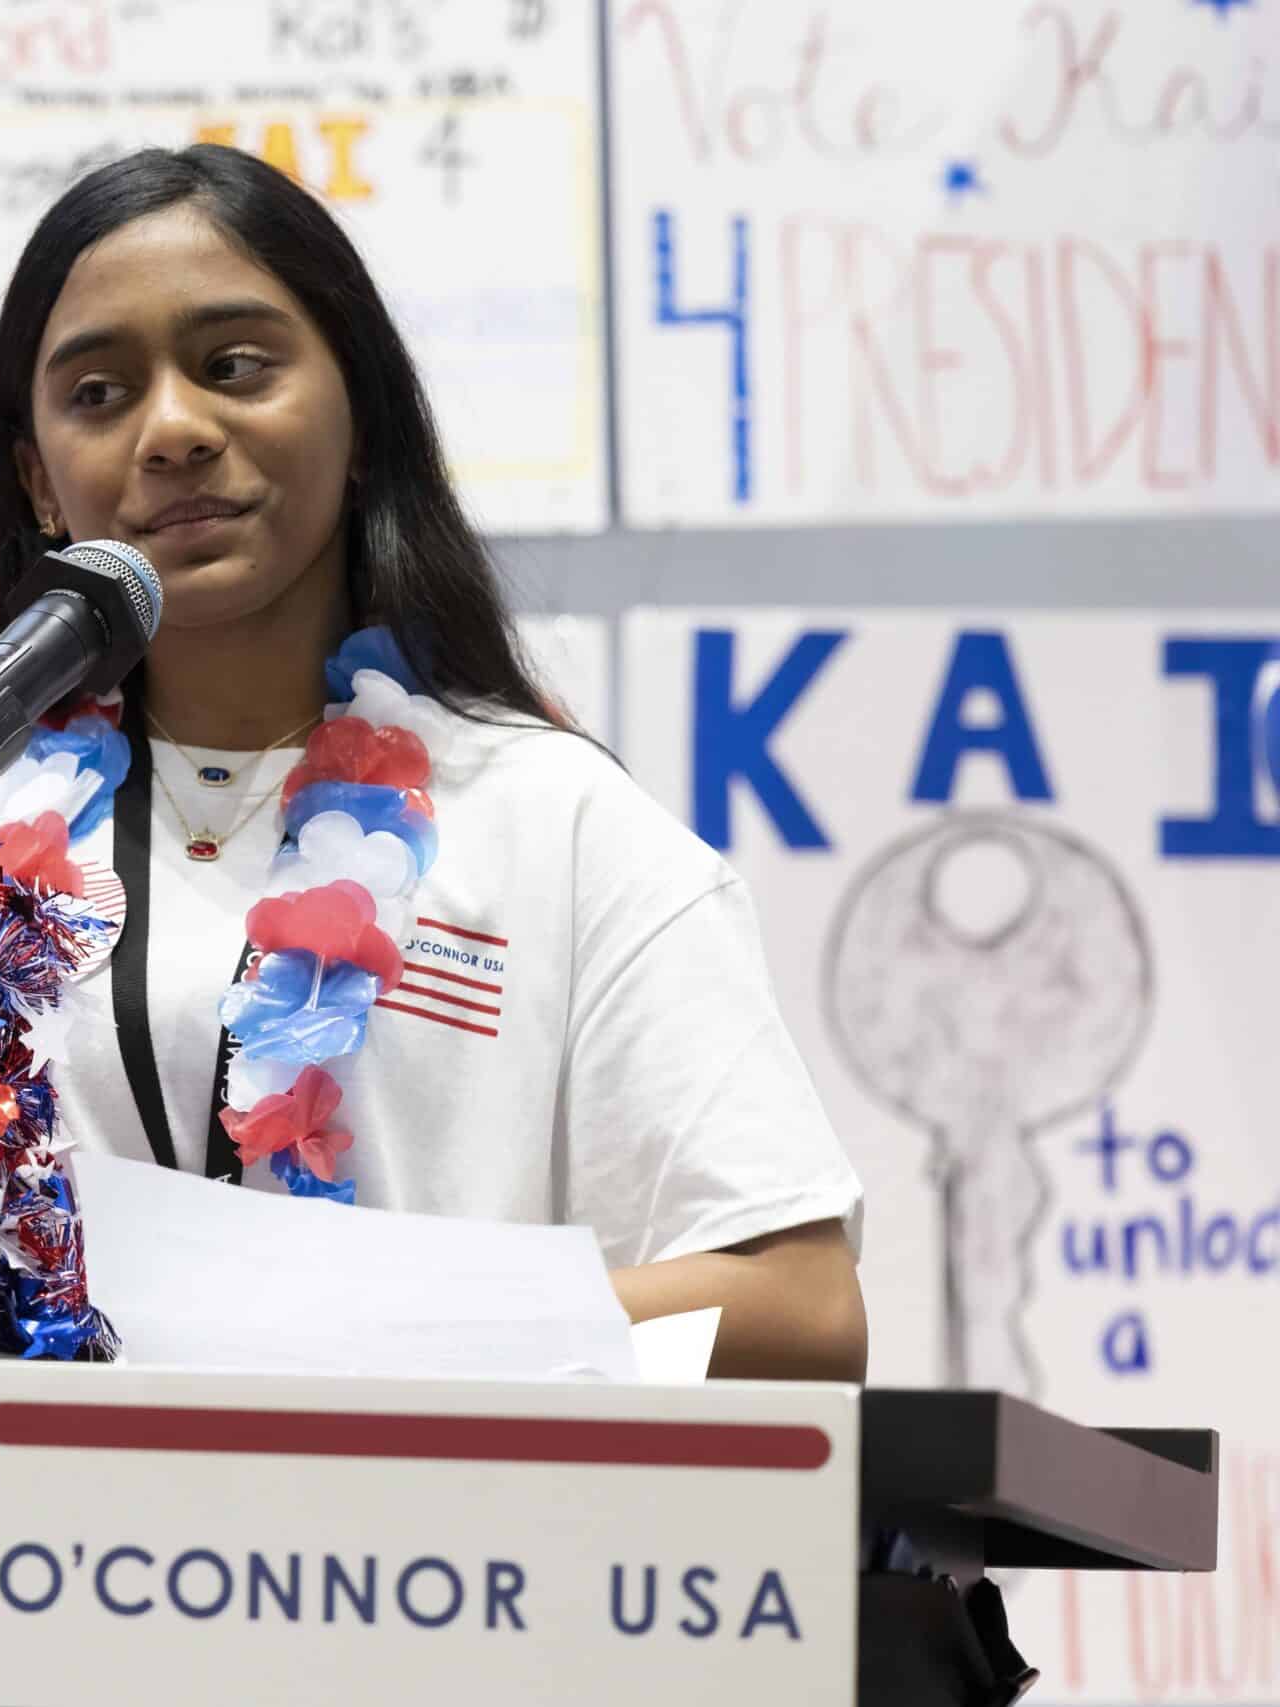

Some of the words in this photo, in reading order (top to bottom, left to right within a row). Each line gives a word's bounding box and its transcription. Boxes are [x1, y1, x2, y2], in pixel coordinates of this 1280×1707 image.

[652, 206, 750, 508] 4
[1074, 1098, 1196, 1194] to
[1098, 1312, 1154, 1378] a
[609, 1562, 803, 1642] USA
